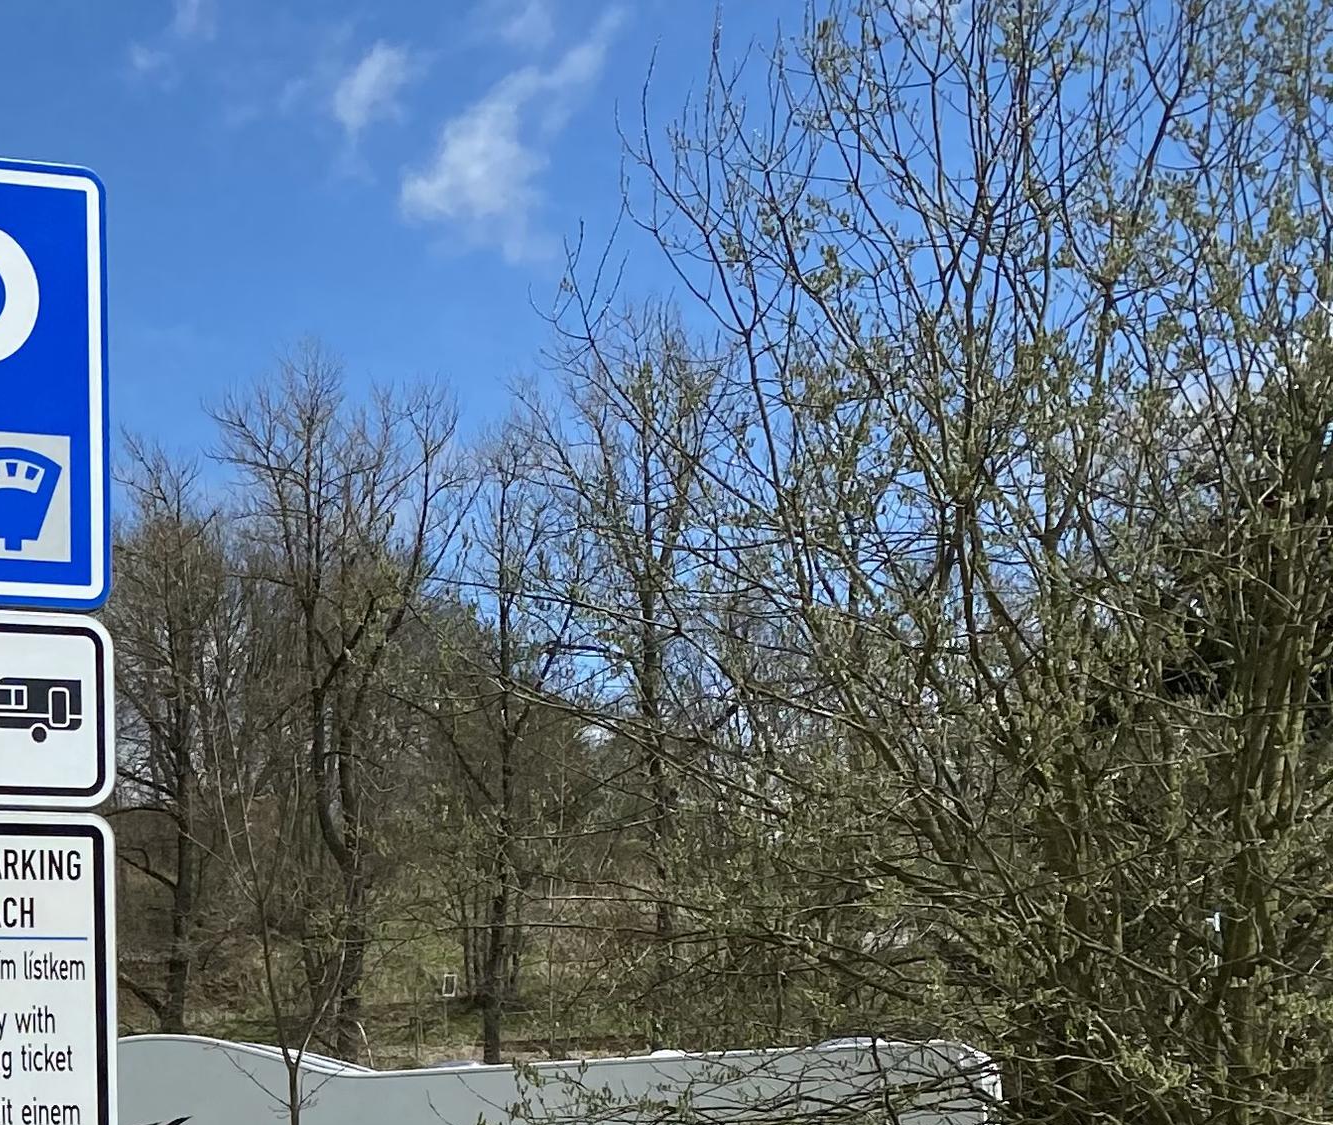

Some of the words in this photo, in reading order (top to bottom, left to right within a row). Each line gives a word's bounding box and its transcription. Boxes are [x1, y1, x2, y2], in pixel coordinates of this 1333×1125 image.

[23, 950, 86, 981] lístkem
[14, 1005, 56, 1034] with
[20, 1043, 74, 1072] ticket
[21, 1096, 81, 1125] einem
